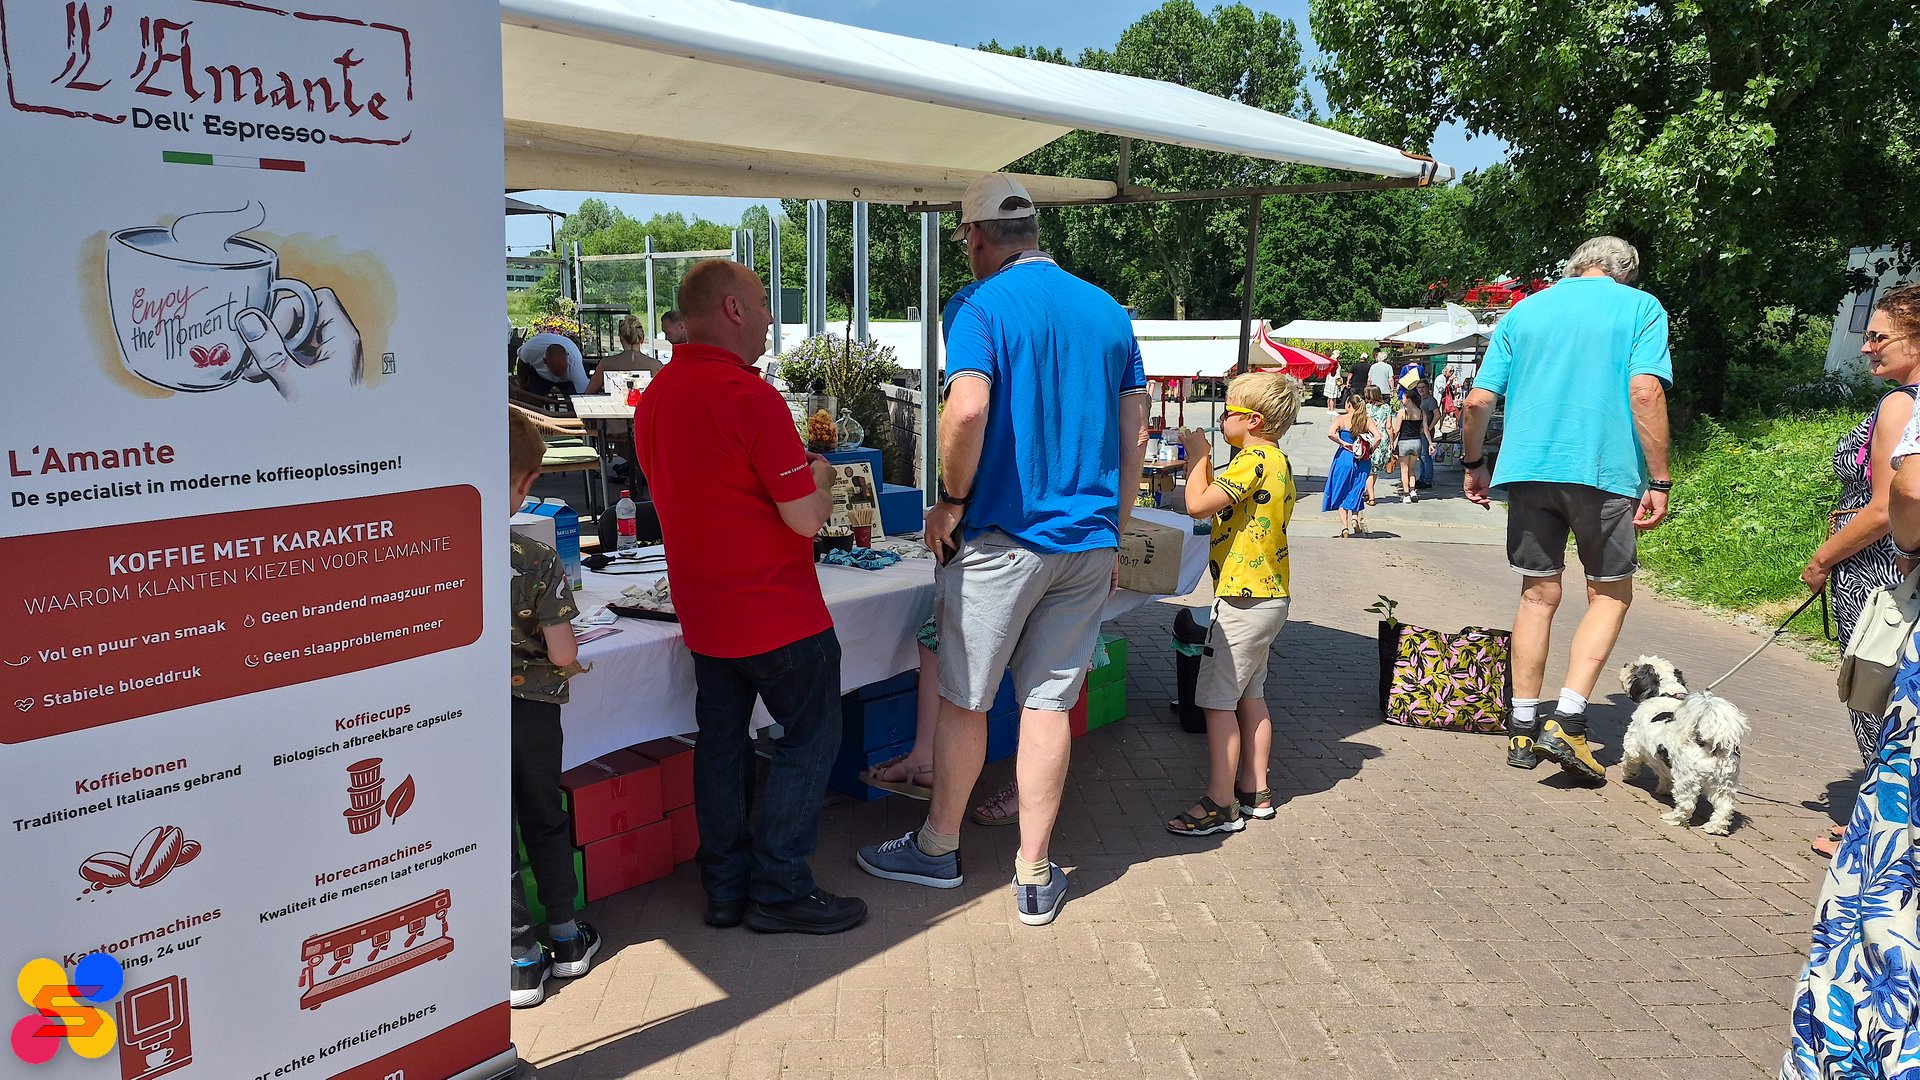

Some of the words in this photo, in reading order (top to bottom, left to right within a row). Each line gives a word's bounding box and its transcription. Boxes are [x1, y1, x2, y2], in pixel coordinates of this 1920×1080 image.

[203, 115, 325, 144] Espresso
[132, 285, 208, 336] Enjoy
[131, 327, 156, 352] the
[8, 441, 175, 477] L'Amante
[12, 492, 39, 507] De
[46, 482, 141, 506] specialist
[148, 479, 164, 493] in
[170, 474, 251, 491] moderne
[257, 456, 401, 483] koffieoplossingen!
[109, 544, 205, 576] KOFFIE
[214, 537, 264, 560] MET
[273, 520, 393, 552] KARAKTER
[24, 584, 129, 614] WAAROM
[138, 569, 237, 598] KLANTEN
[245, 558, 315, 582] KIEZEN
[320, 551, 368, 570] VOOR
[262, 611, 297, 624] Geen
[303, 596, 366, 616] brandend
[371, 586, 431, 604] maagzuur
[435, 579, 464, 591] meer
[38, 647, 67, 663] Vol
[72, 646, 92, 657] en
[99, 637, 137, 655] puur
[142, 632, 169, 644] van
[175, 620, 226, 639] smaak
[264, 650, 299, 663] Geen
[304, 628, 409, 656] slaapproblemen
[412, 620, 443, 633] meer
[43, 685, 114, 707] Stabiele
[120, 666, 201, 692] bloeddruk
[274, 742, 339, 766] Biologisch
[343, 724, 413, 749] afbreekbare
[417, 710, 462, 728] capsules
[336, 705, 411, 731] Koffiecups
[13, 798, 112, 831] Traditioneel
[117, 783, 180, 806] Italiaans
[184, 765, 241, 791] gebrand
[76, 759, 186, 794] Koffiebonen
[260, 898, 316, 923] Kwaliteit
[320, 892, 338, 903] die
[342, 876, 387, 896] mensen
[391, 866, 411, 880] laat
[415, 843, 476, 871] terugkomen
[316, 841, 432, 886] Horecamachines
[157, 944, 173, 958] 24
[178, 936, 201, 950] uur
[275, 1055, 315, 1077] echte
[320, 1005, 436, 1059] koffieliefhebbers
